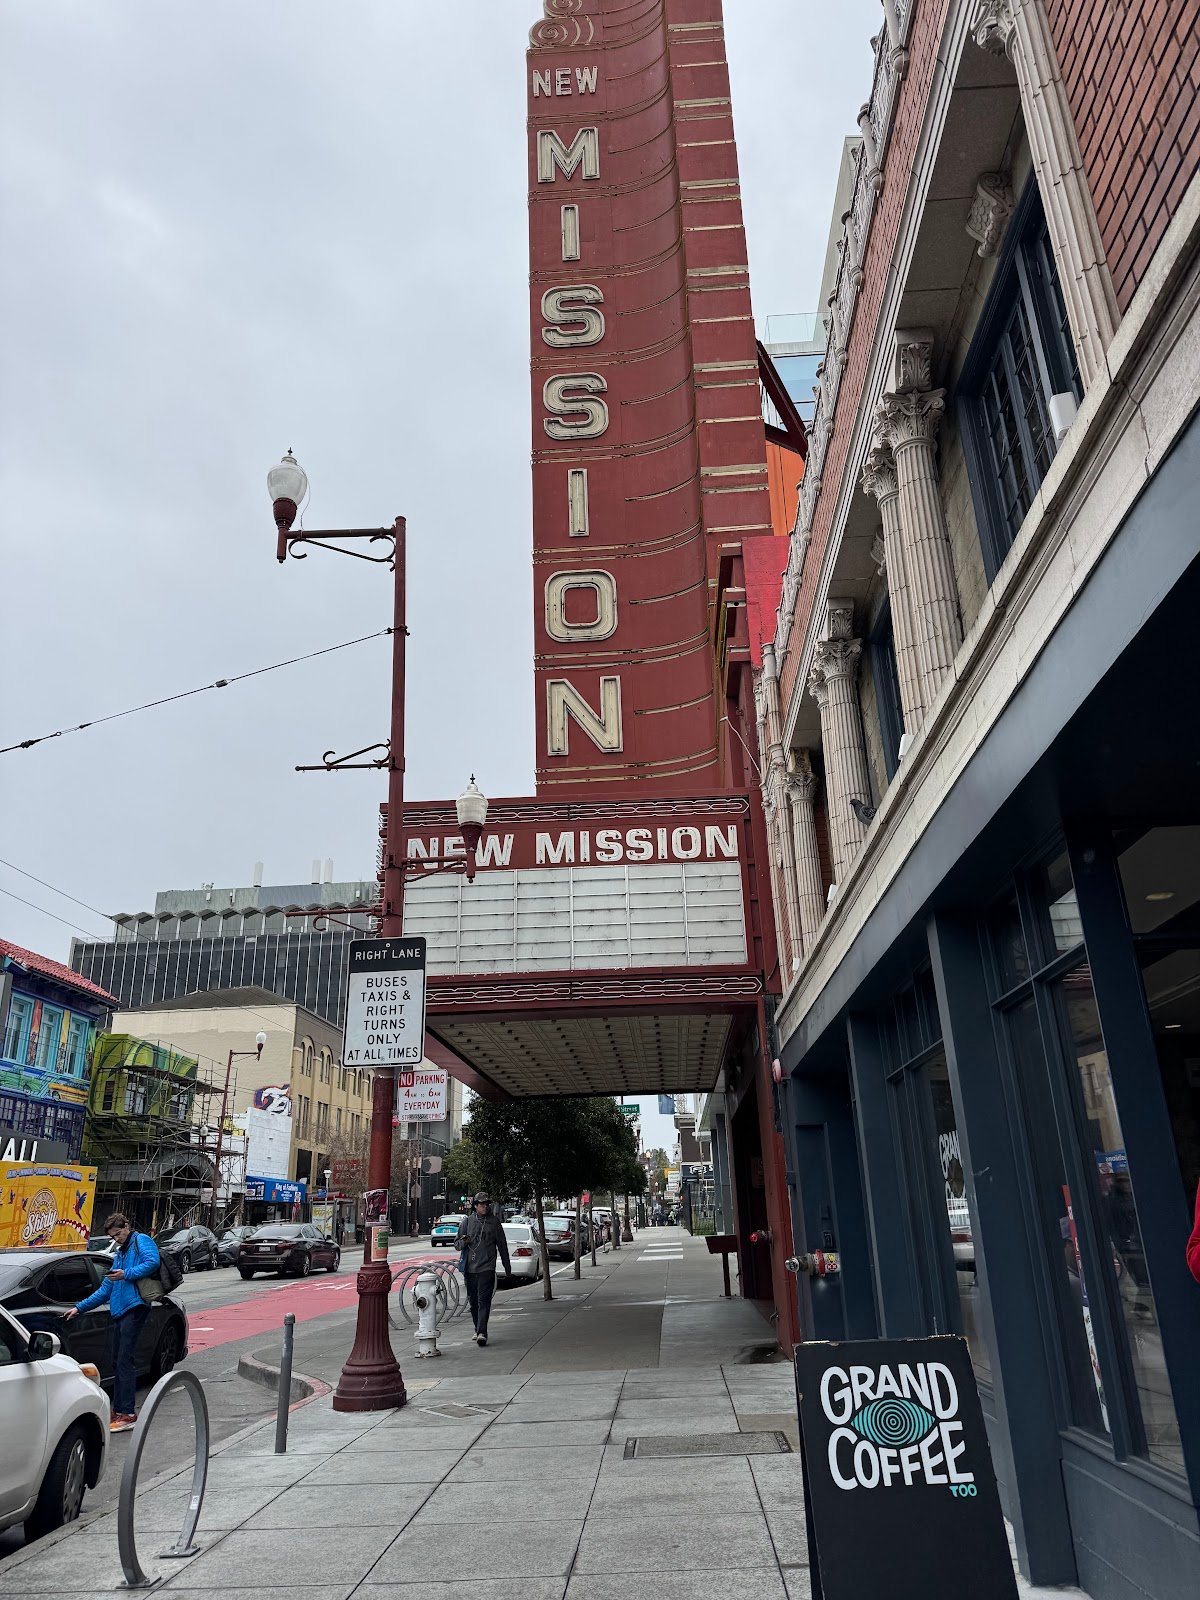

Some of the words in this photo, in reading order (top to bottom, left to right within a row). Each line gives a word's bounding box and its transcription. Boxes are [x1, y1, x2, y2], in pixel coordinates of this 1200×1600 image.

[532, 66, 599, 97] NEW
[536, 126, 624, 757] MISSION
[406, 833, 515, 870] NEW
[535, 825, 739, 864] MISSION
[355, 950, 388, 961] RIGHT
[391, 948, 421, 959] LANE
[366, 976, 408, 988] BUSES
[360, 991, 397, 1003] TAXIS
[402, 990, 411, 1001] &
[366, 1004, 405, 1017] RIGHT
[363, 1018, 406, 1031] TURNS
[367, 1033, 401, 1046] ONLY
[347, 1049, 360, 1061] AT
[363, 1048, 381, 1060] ALL
[387, 1046, 418, 1059] TIMES
[400, 1073, 413, 1086] NO
[415, 1074, 445, 1085] PARKING
[404, 1101, 440, 1111] EVERYDAY
[820, 1362, 959, 1425] GRAND
[827, 1420, 975, 1491] COFFEE
[949, 1483, 978, 1497] TOO
